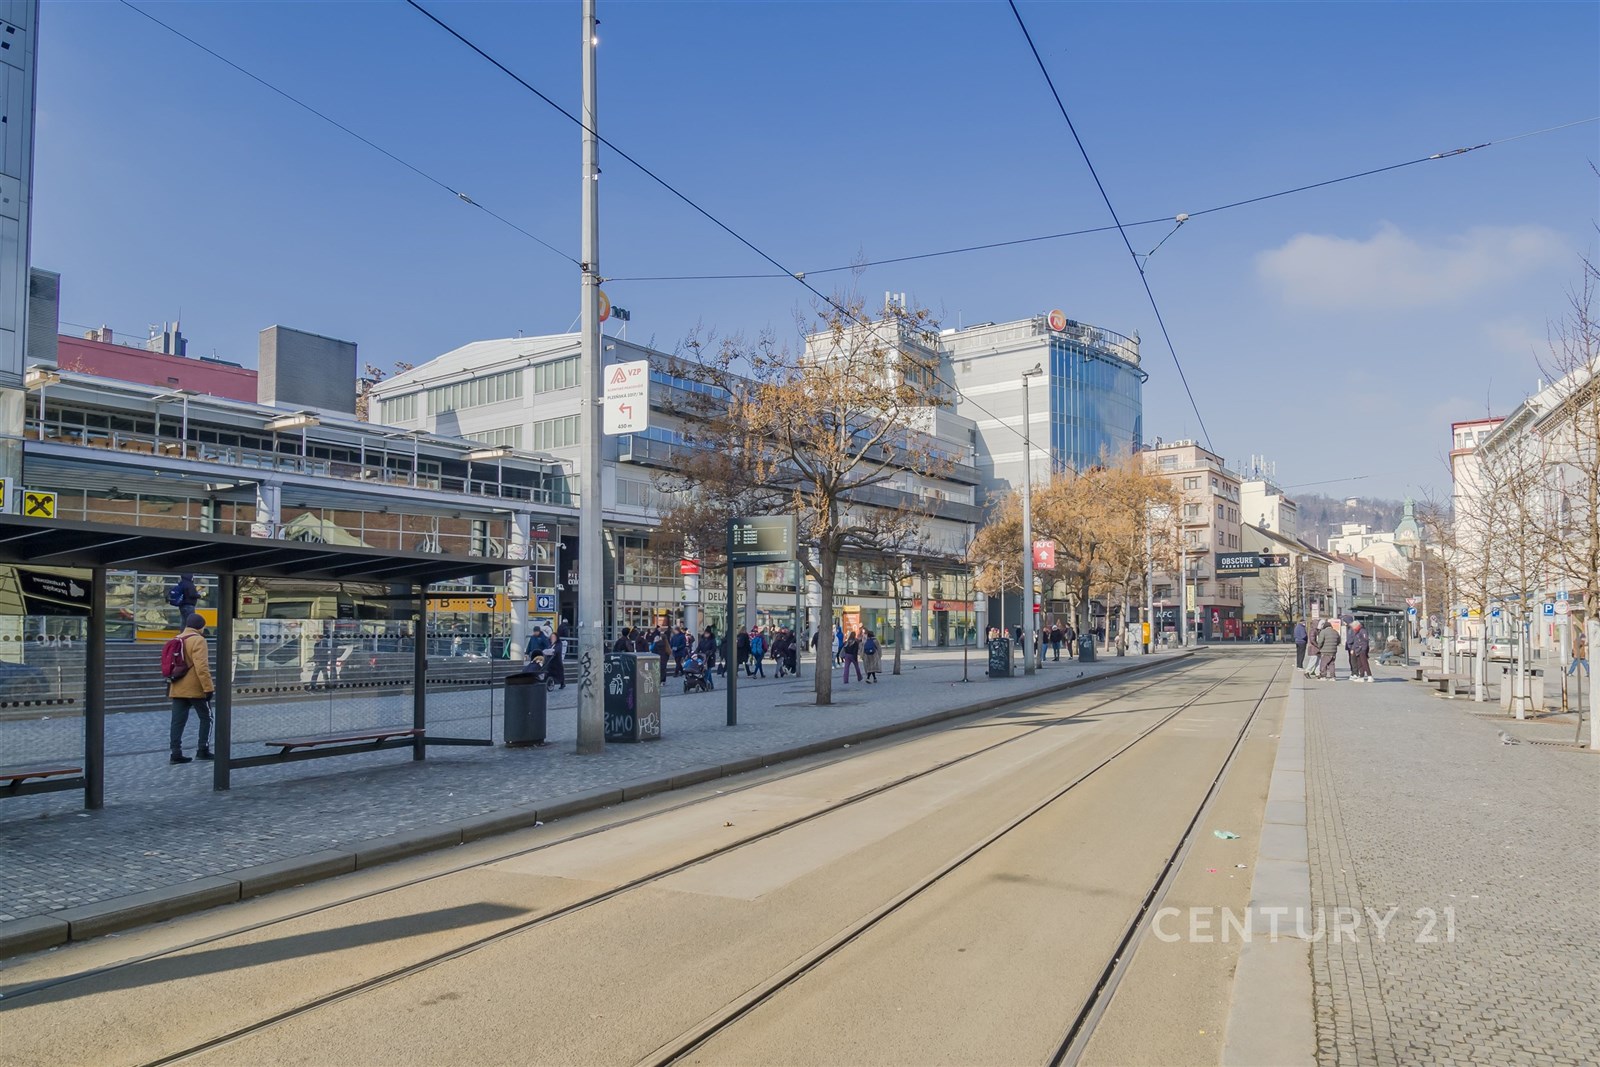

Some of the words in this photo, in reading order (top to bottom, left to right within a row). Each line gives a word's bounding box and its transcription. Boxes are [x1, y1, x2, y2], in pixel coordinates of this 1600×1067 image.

[628, 368, 641, 376] VZP
[1221, 556, 1253, 565] OBSCURE
[708, 592, 743, 601] DELMRT
[1545, 604, 1553, 612] P
